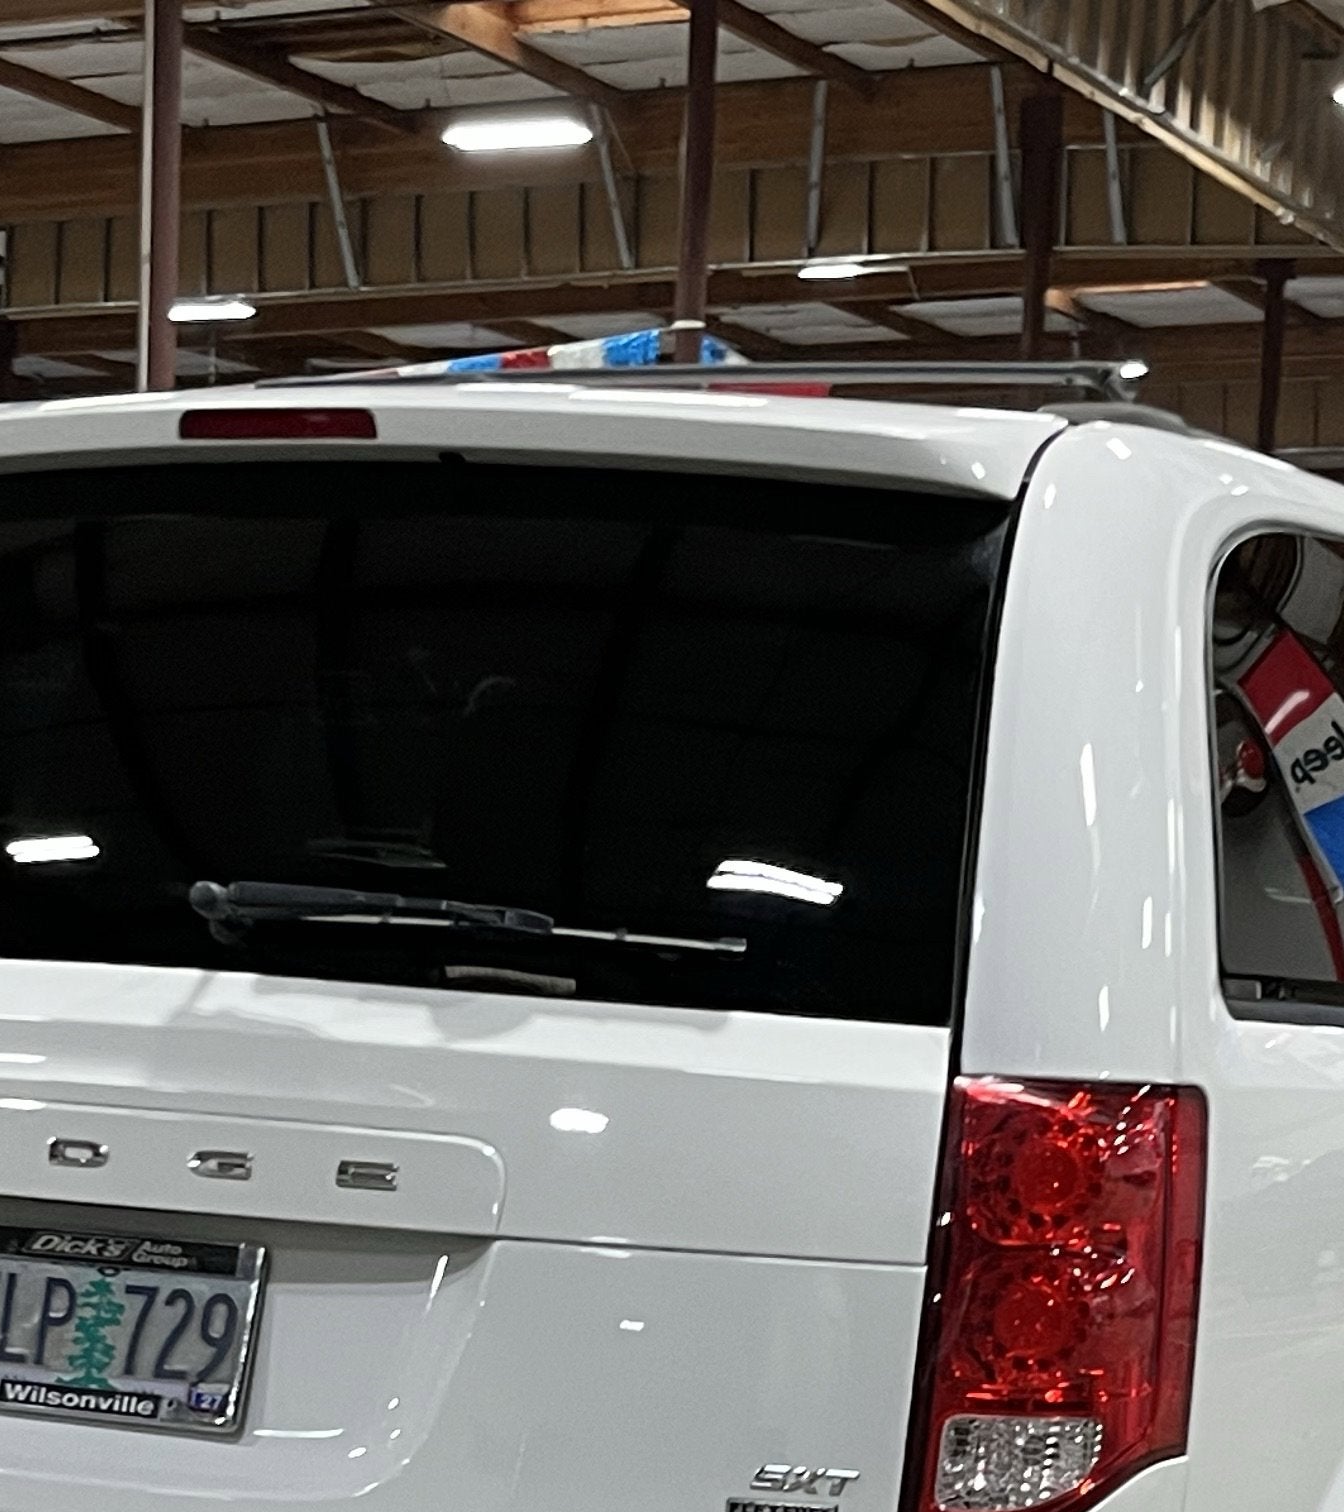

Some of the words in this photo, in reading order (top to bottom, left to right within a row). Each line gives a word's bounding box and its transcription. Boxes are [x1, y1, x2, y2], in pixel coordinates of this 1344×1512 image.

[30, 1233, 128, 1258] Dick's
[131, 1251, 190, 1269] Group
[138, 1240, 183, 1255] Auto
[124, 1284, 239, 1381] 729
[2, 1382, 155, 1417] Wilsonville
[749, 1464, 861, 1497] SXT
